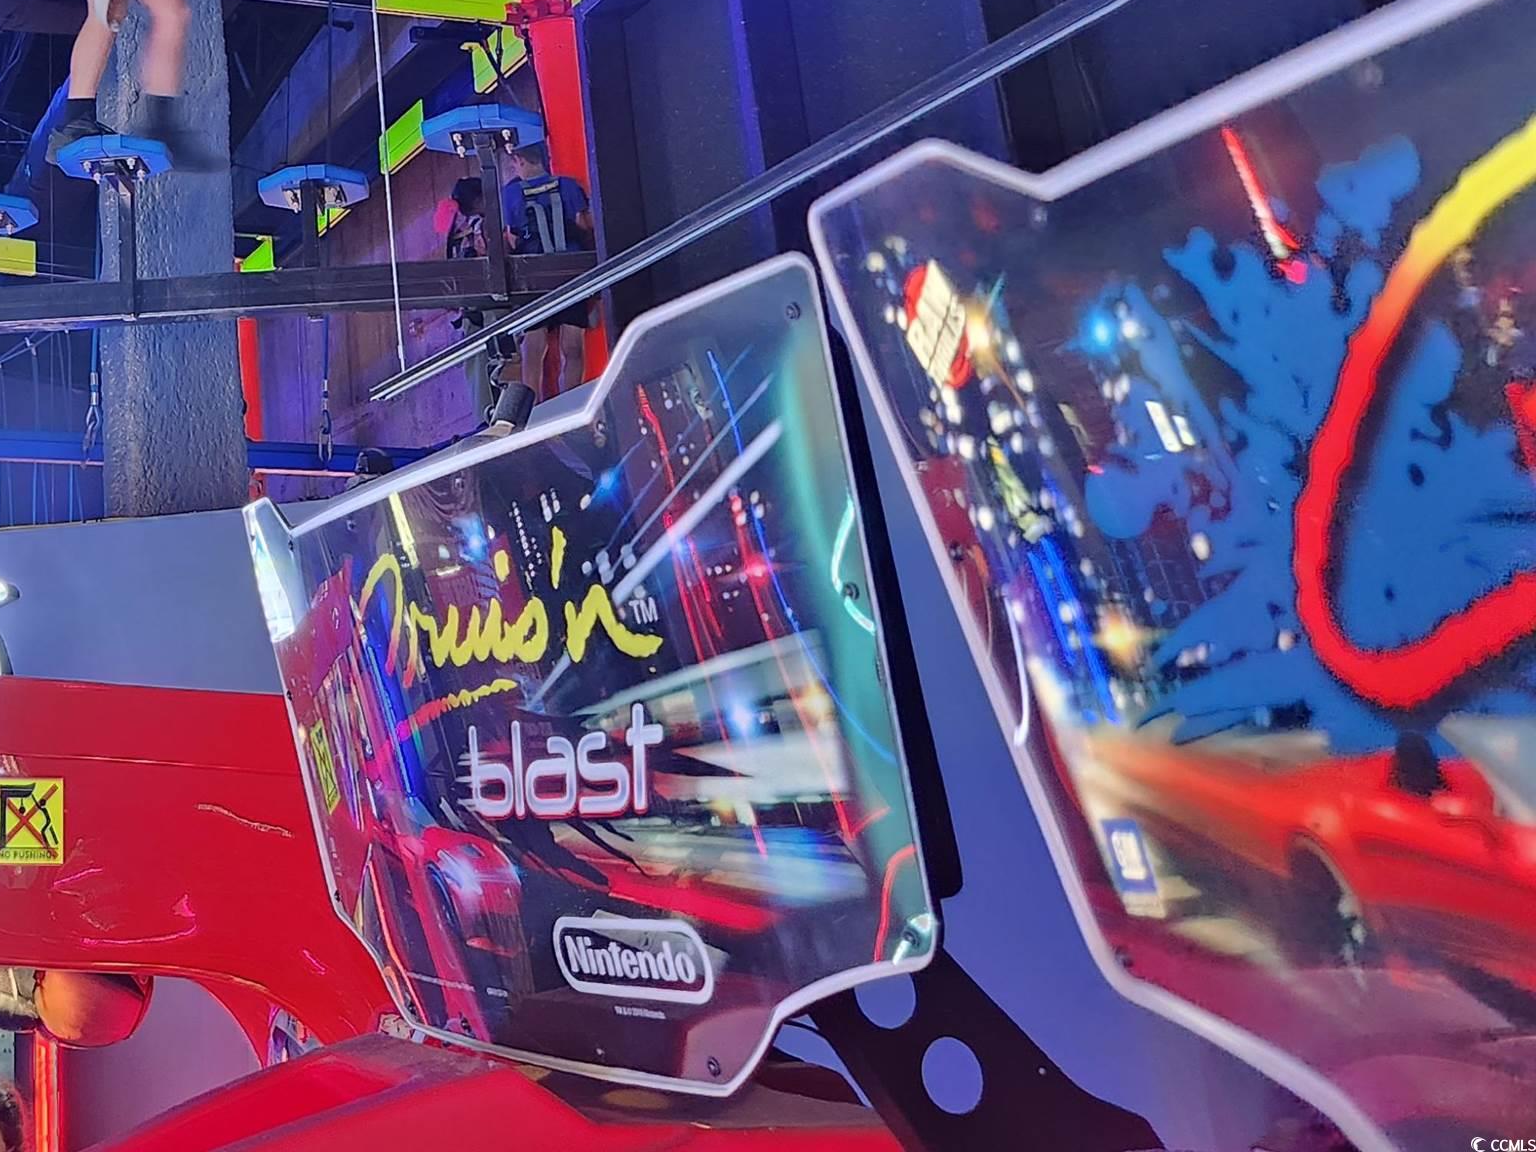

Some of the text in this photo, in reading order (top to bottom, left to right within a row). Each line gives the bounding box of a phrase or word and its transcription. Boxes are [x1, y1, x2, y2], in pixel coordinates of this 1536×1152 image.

[358, 526, 663, 689] Cruis'n TM
[462, 703, 664, 821] blast
[13, 850, 52, 860] PUSHING
[564, 935, 697, 984] Nintendo
